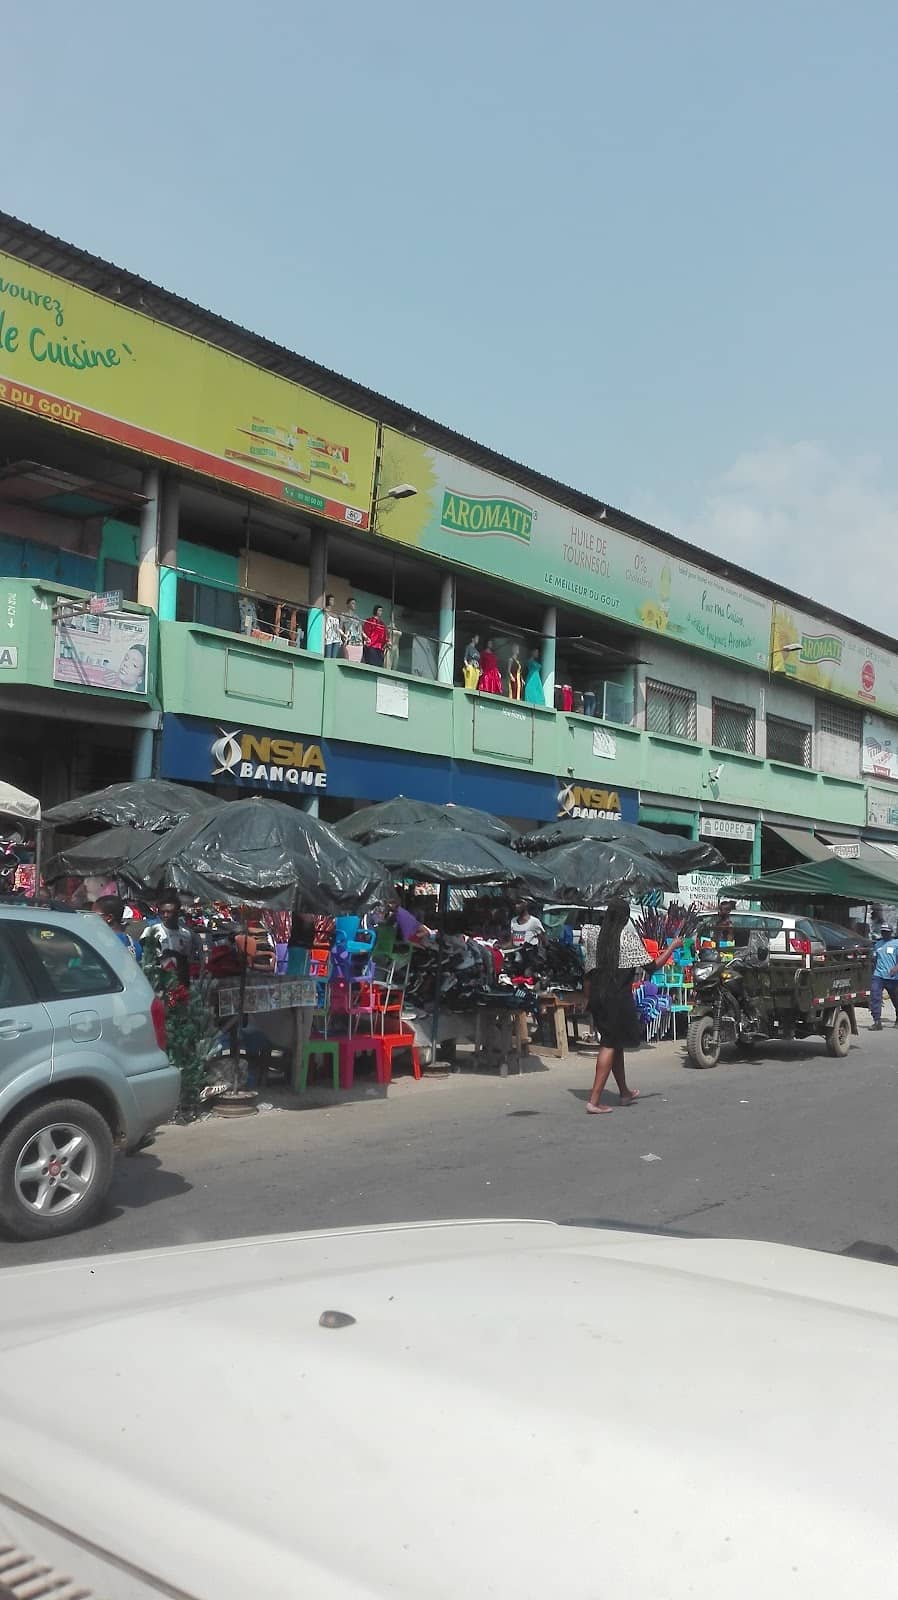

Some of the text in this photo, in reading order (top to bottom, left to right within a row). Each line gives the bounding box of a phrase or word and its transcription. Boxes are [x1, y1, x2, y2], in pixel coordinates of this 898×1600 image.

[29, 327, 121, 370] Cuisine
[11, 387, 34, 406] DU
[38, 399, 81, 424] GOÛT
[443, 495, 532, 536] AROMATE
[571, 527, 607, 556] HUILE DE
[563, 543, 611, 578] TOURNESOL
[634, 554, 648, 574] 0%
[544, 572, 620, 609] LE MEILLEUR DU GOUT
[241, 734, 326, 771] NSIA
[240, 762, 327, 787] BANQUE
[573, 785, 621, 812] NSIA
[713, 821, 745, 834] COOPEC
